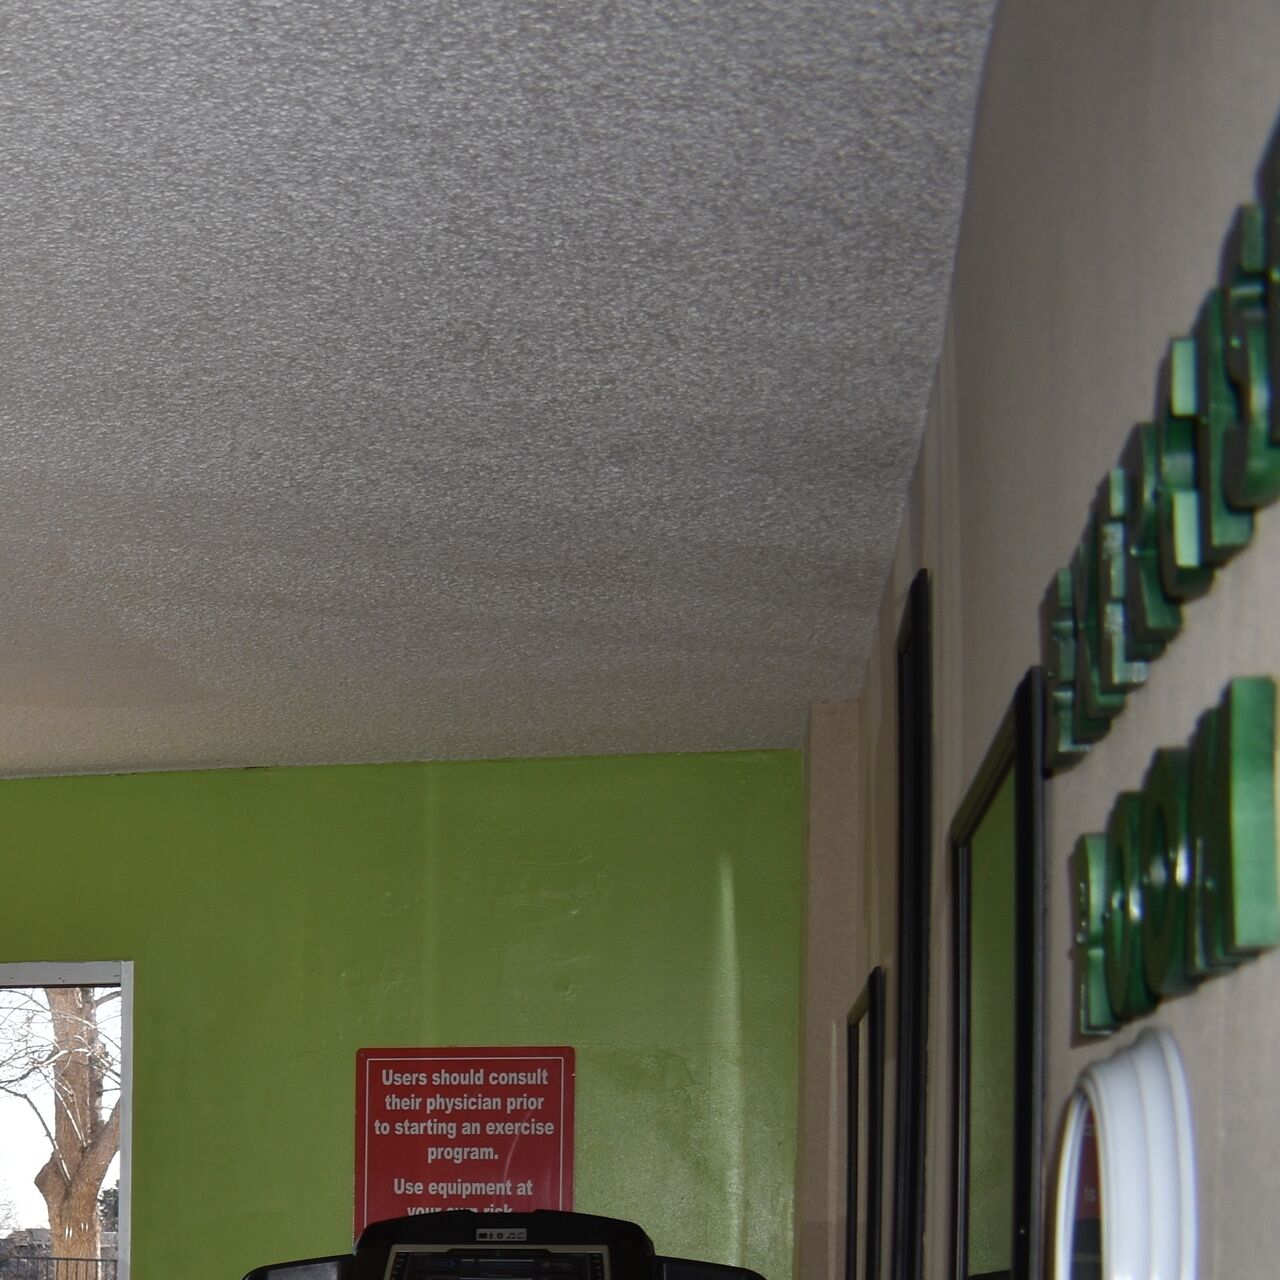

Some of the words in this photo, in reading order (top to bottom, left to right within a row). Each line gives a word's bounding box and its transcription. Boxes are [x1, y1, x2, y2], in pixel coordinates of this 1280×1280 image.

[381, 1069, 427, 1085] Users
[432, 1068, 484, 1085] should
[489, 1068, 548, 1085] consult
[385, 1093, 421, 1110] their
[426, 1093, 502, 1114] physician
[506, 1094, 544, 1113] prior
[374, 1120, 390, 1135] to
[394, 1119, 457, 1139] starting
[461, 1121, 481, 1135] an
[486, 1119, 554, 1135] exercise
[427, 1146, 499, 1164] program.
[393, 1178, 423, 1195] Use
[428, 1179, 512, 1198] equipment
[516, 1182, 533, 1196] at
